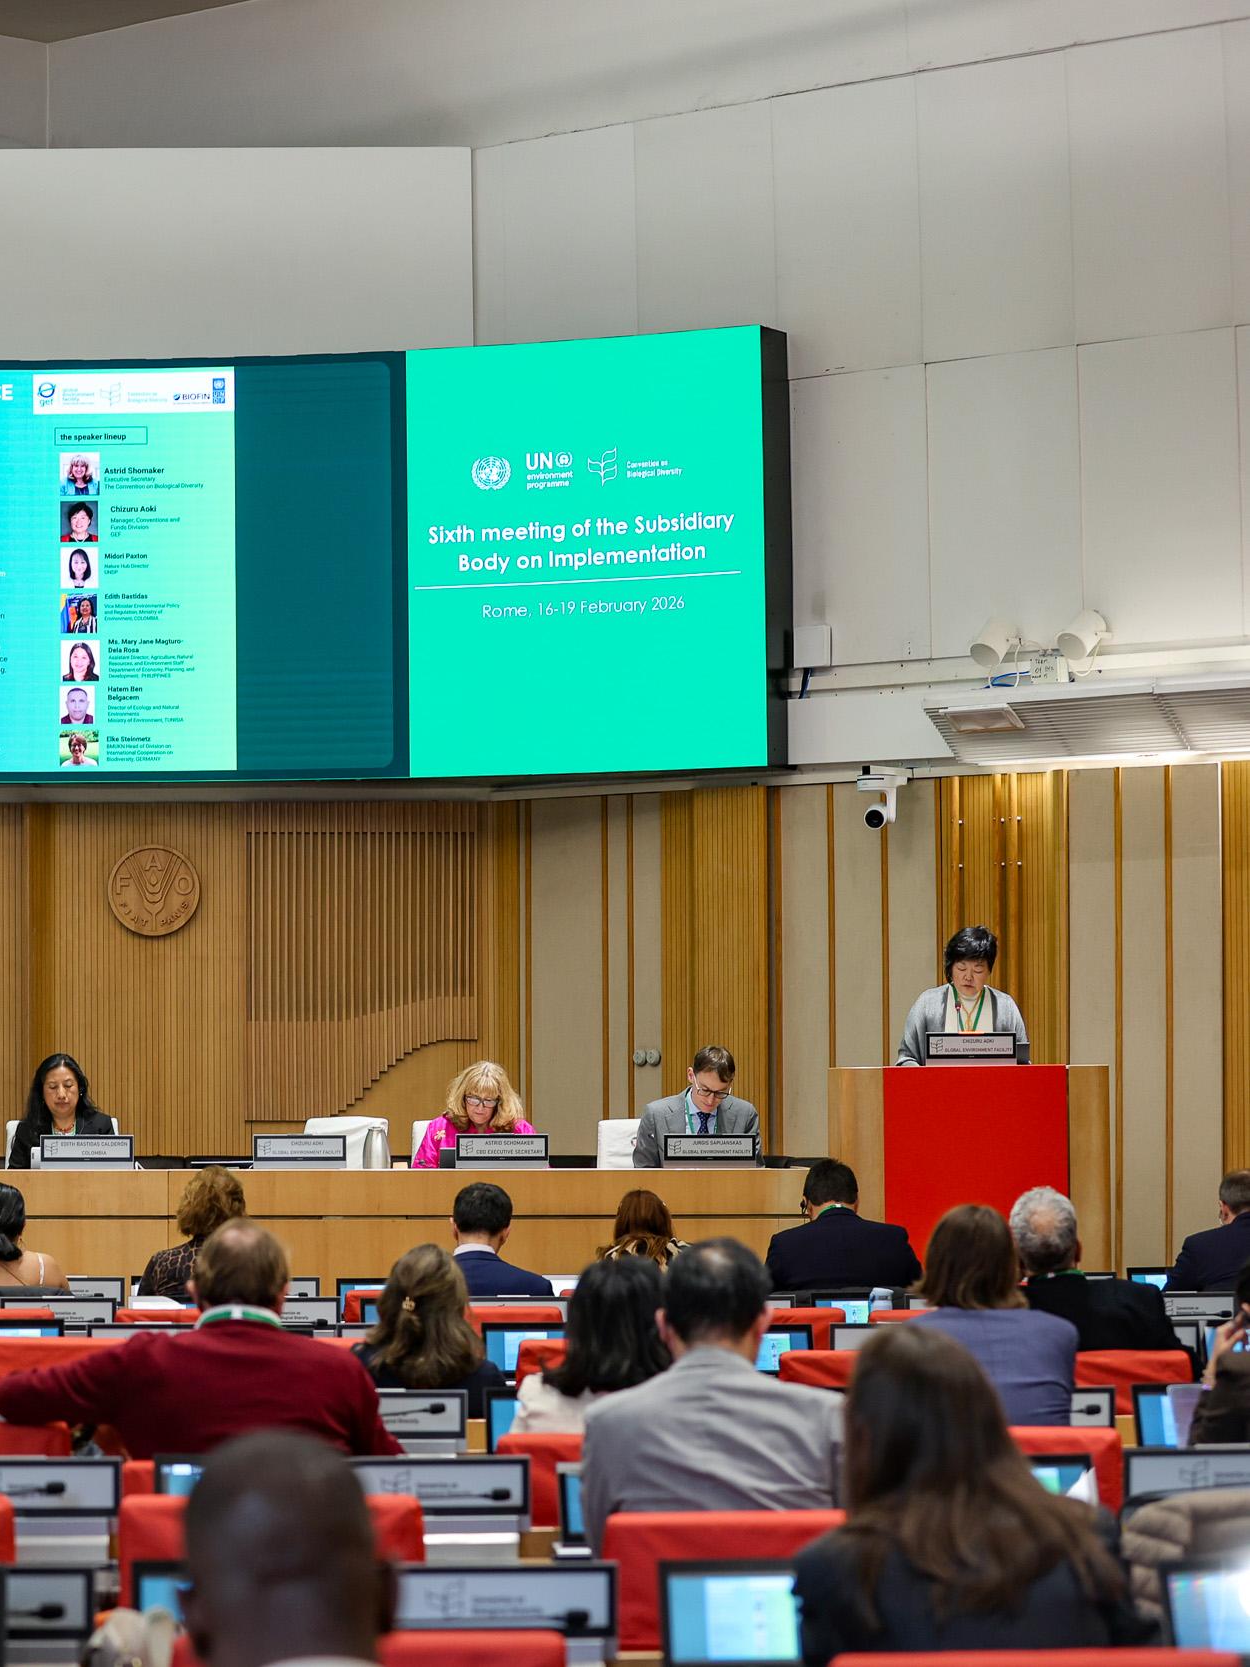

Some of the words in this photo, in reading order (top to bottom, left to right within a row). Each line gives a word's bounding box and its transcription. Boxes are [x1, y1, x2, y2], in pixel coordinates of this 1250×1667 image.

[182, 393, 211, 401] BIOFIN
[74, 434, 103, 443] speaker
[104, 433, 127, 442] lineup
[525, 452, 553, 471] UN
[626, 459, 660, 469] Convention
[526, 471, 573, 481] environment
[626, 469, 656, 479] Biological
[656, 467, 683, 478] Diversity
[526, 479, 570, 490] programme
[140, 505, 157, 513] Aoki
[428, 524, 475, 545] Sixth
[481, 521, 566, 543] meeting
[571, 519, 592, 538] of
[596, 517, 628, 536] the
[634, 511, 735, 534] Subsidiary
[458, 552, 510, 575] Body
[516, 554, 543, 569] on
[549, 542, 706, 570] Implementation
[482, 603, 533, 620] Rome,
[538, 601, 575, 616] 16-19
[580, 597, 647, 616] February
[651, 595, 685, 611] 2026
[155, 638, 184, 646] Magturo-
